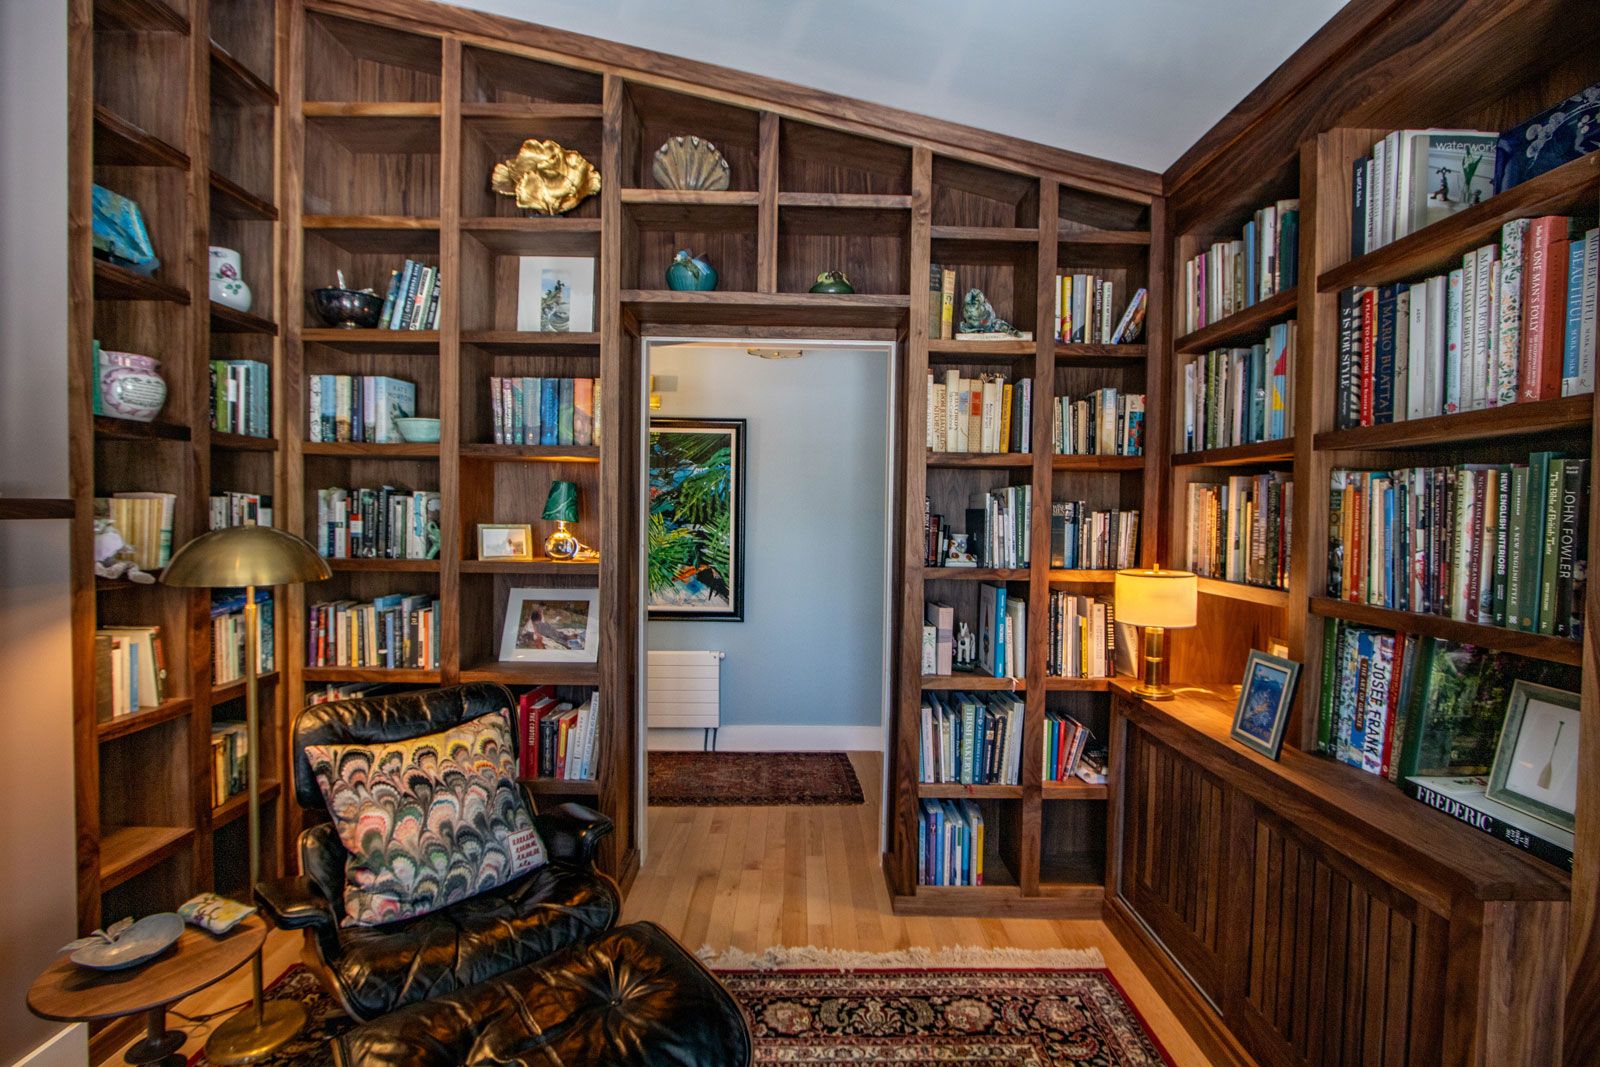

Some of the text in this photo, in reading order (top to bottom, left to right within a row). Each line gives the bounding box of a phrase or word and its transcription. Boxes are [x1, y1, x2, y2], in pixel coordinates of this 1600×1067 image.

[1435, 140, 1497, 153] waterwork
[1533, 251, 1543, 270] ONE
[1463, 260, 1473, 311] MARKHAM
[1478, 253, 1488, 309] MARKHAM
[1531, 273, 1541, 303] MAN'S
[1570, 250, 1584, 325] BEAUTIFUL
[1584, 267, 1597, 323] BEAUTIFUL
[1342, 318, 1351, 329] IS
[1364, 327, 1370, 335] TO
[1477, 311, 1487, 355] ROBERTS
[1529, 305, 1539, 332] FOLLY
[1342, 331, 1350, 352] FOR
[1462, 316, 1472, 359] ROBERTS
[1379, 306, 1392, 408] MARIO BUATTA
[1457, 474, 1466, 517] COLEFAX
[1500, 473, 1508, 492] NEW
[1549, 472, 1559, 486] The
[1499, 494, 1507, 530] ENGLISH
[1549, 488, 1558, 505] Bible
[1549, 506, 1557, 514] of
[1562, 490, 1576, 523] JOHN
[1474, 501, 1482, 535] HASLAM'S
[1547, 514, 1555, 536] British
[1454, 530, 1463, 569] FOWLER
[1497, 532, 1506, 575] INTERIORS
[1512, 551, 1520, 581] ENGLISH
[1559, 528, 1573, 578] FOWLER
[1470, 563, 1478, 600] GRANDEUR
[1510, 583, 1518, 606] STYLE
[1358, 693, 1365, 701] OF
[1366, 663, 1386, 756] JOSEF FRANK
[964, 712, 973, 773] IRISH BAKERY
[1417, 786, 1493, 832] FREDERIC
